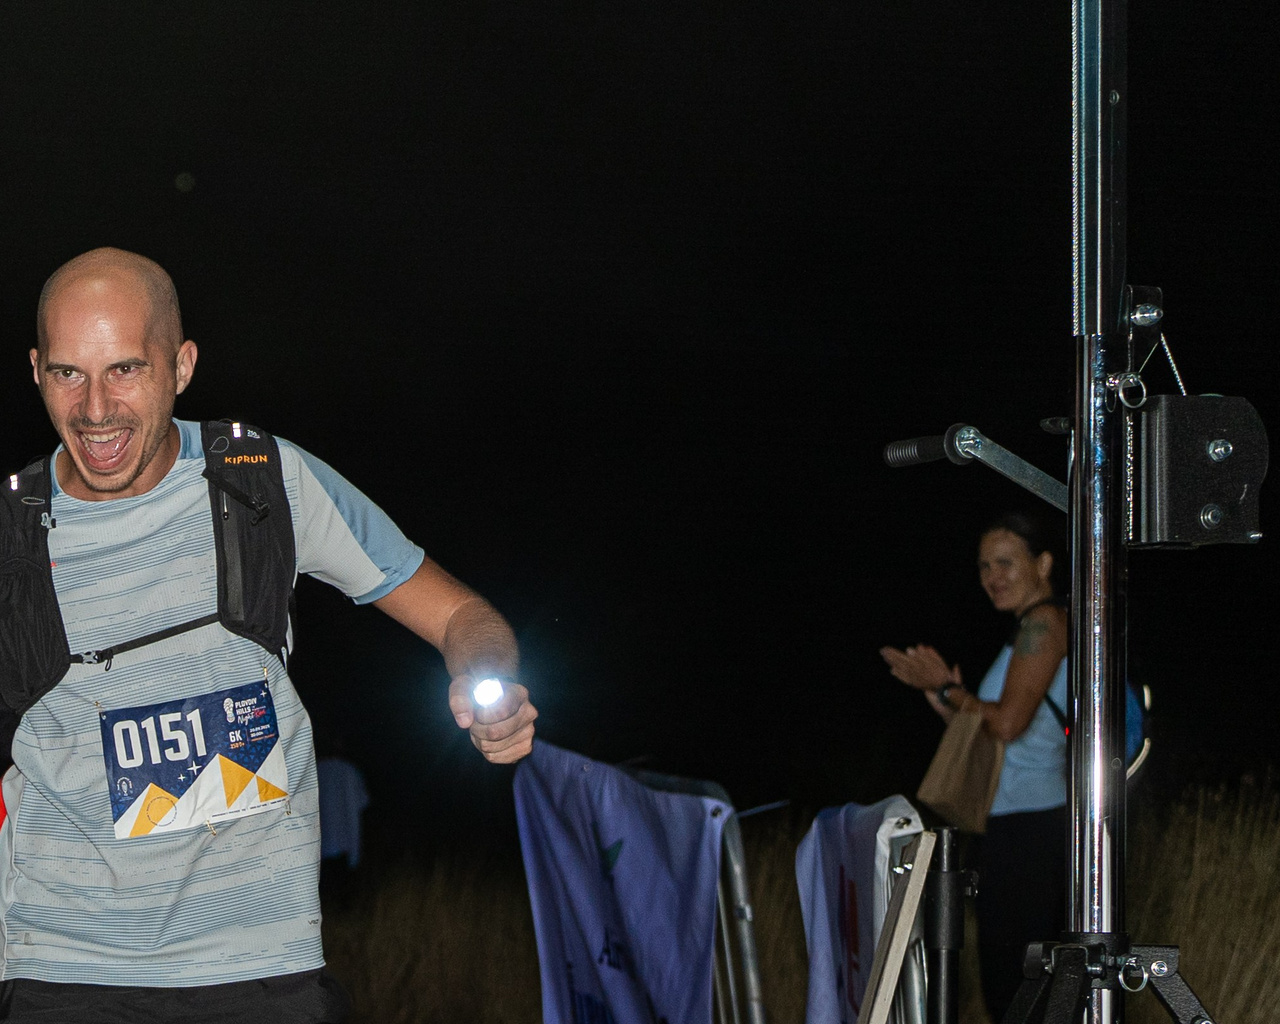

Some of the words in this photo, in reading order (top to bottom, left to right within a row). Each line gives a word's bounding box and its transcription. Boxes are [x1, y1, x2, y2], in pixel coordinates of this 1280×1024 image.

[224, 455, 268, 465] KIPRUN
[113, 708, 207, 769] 0151
[229, 730, 243, 743] 6K
